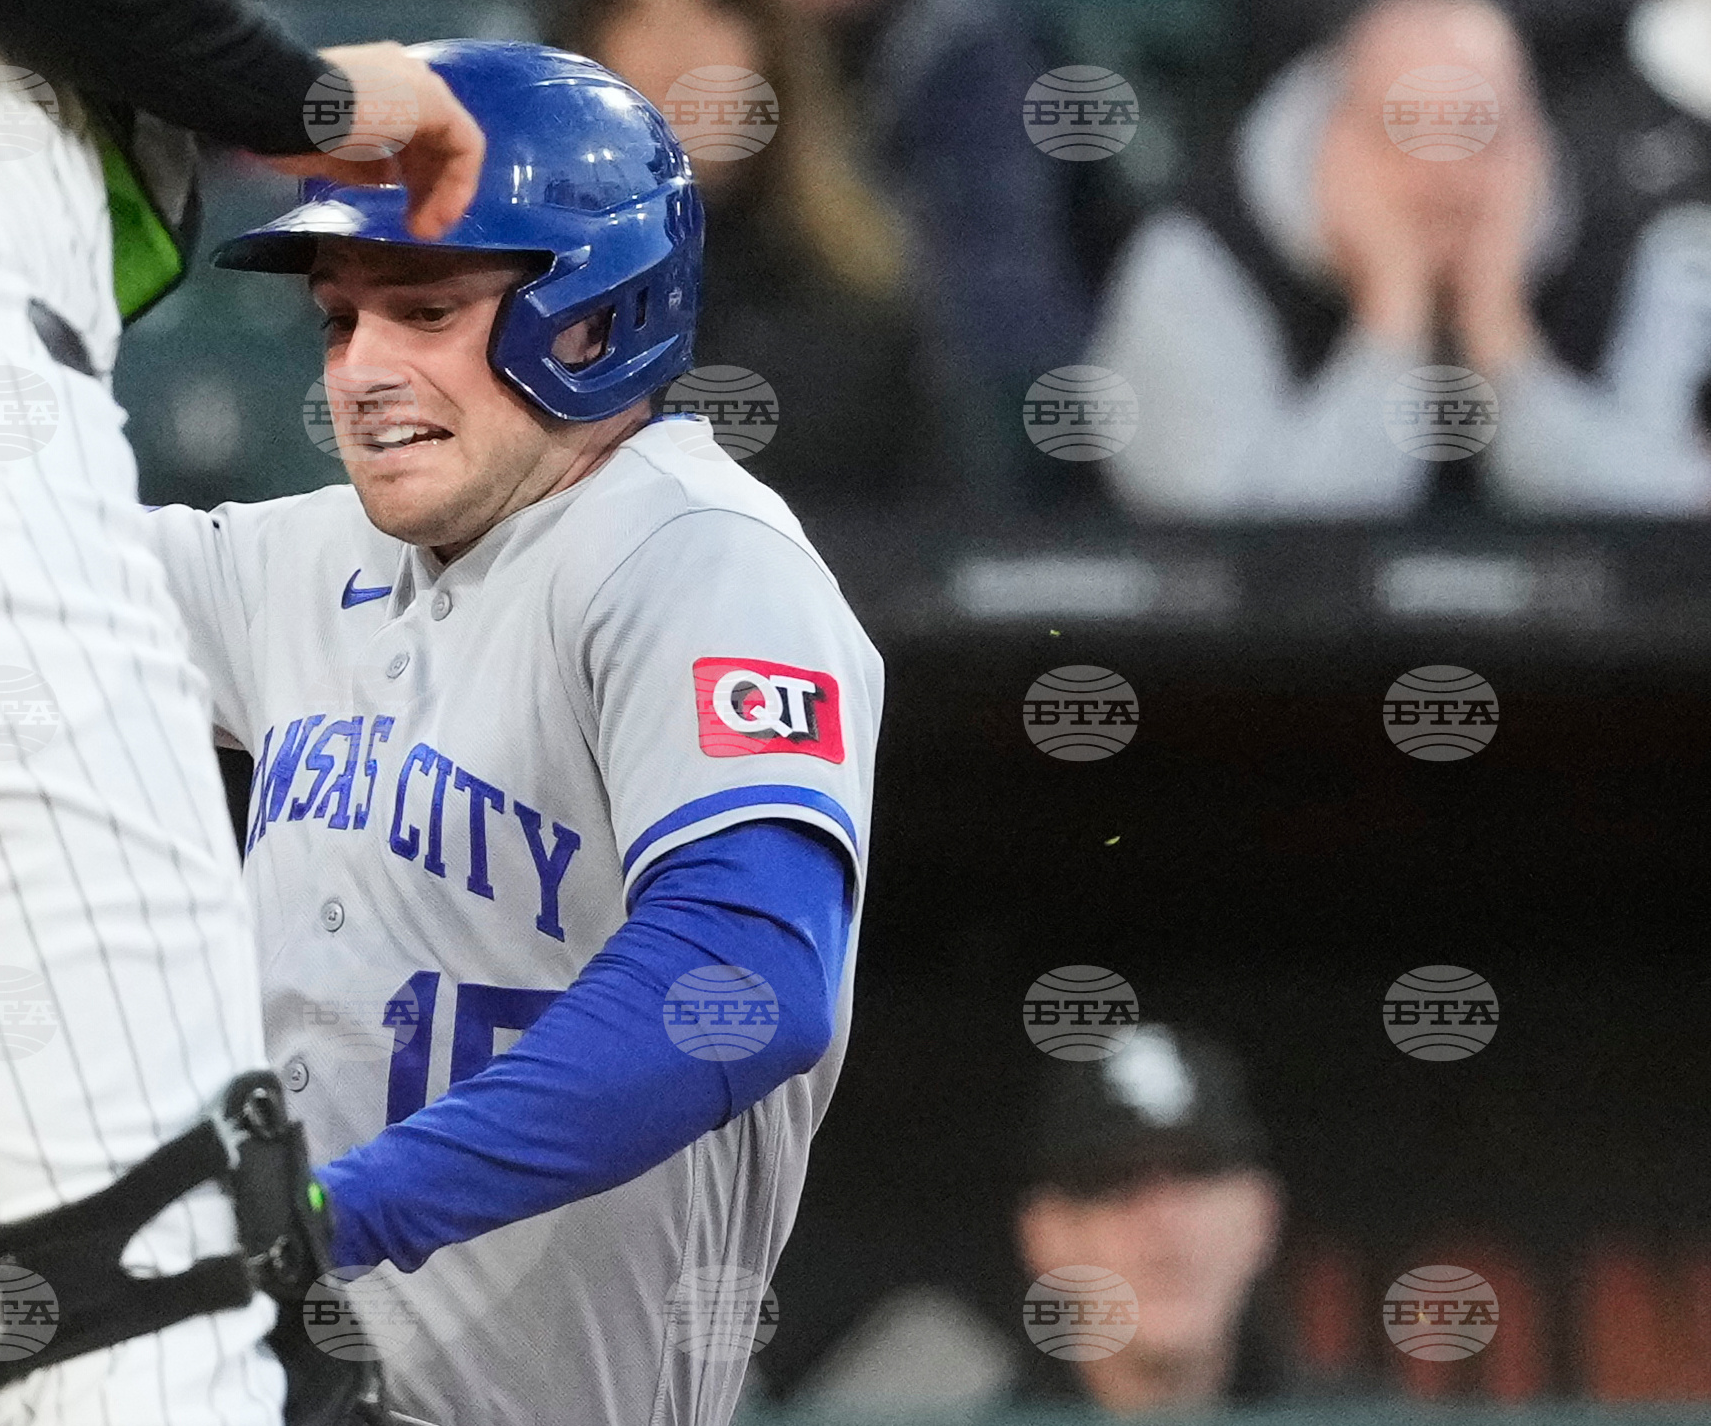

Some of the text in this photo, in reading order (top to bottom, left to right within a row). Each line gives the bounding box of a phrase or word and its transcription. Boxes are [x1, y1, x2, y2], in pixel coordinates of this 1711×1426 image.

[713, 669, 817, 738] QT
[247, 713, 581, 942] ANSAS CITY
